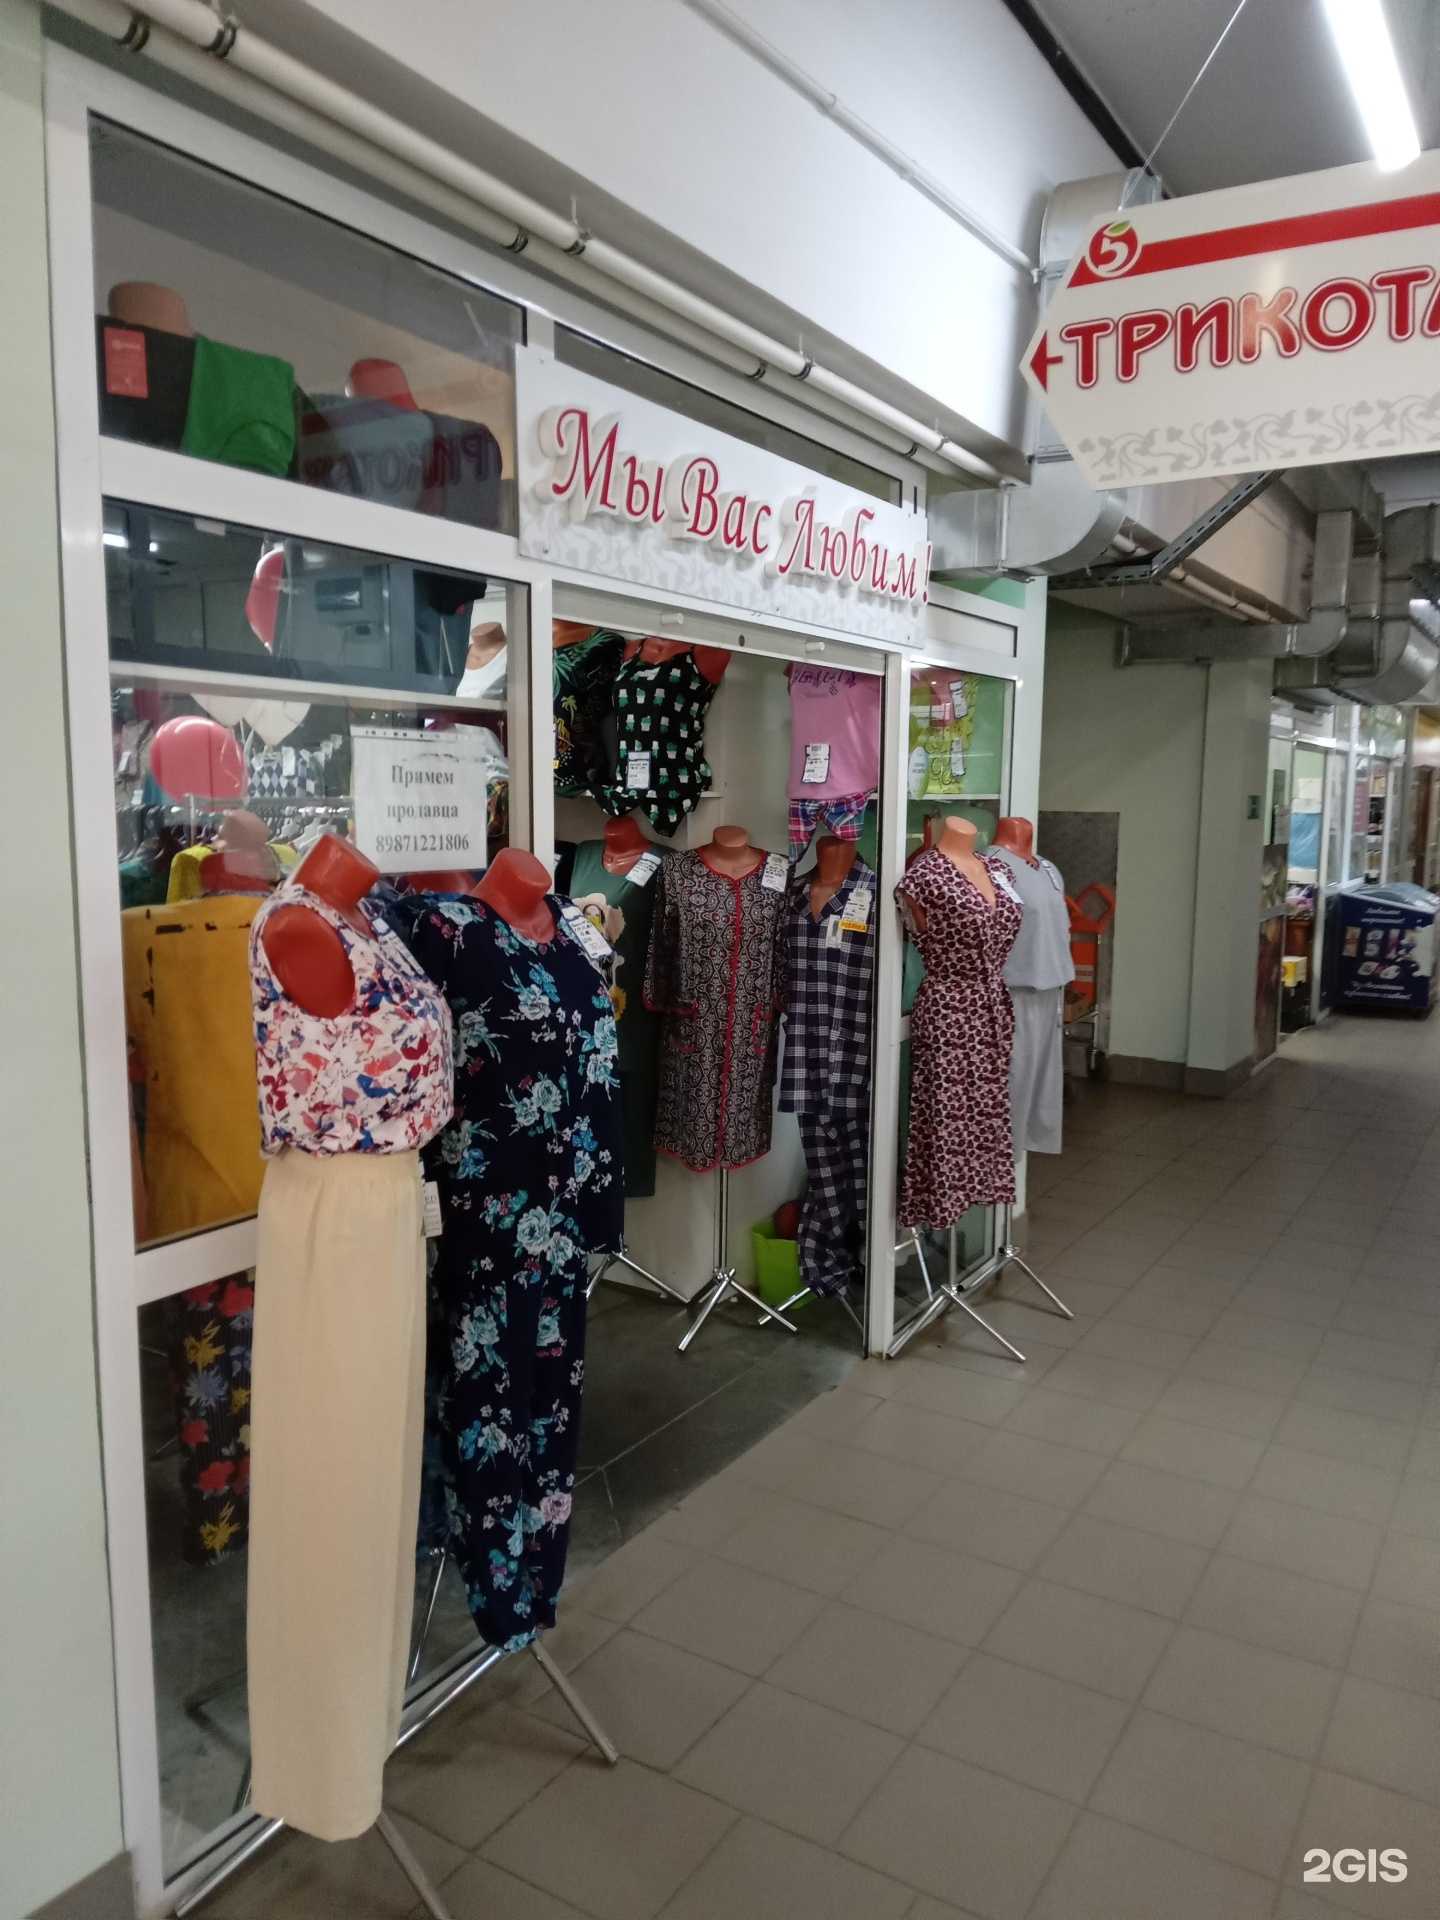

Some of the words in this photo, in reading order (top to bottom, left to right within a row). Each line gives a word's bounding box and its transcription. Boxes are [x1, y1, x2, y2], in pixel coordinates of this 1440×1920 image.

[550, 407, 666, 524] Мы
[680, 456, 773, 554] Вас
[391, 764, 454, 788] Примем
[375, 832, 470, 853] 89871221806
